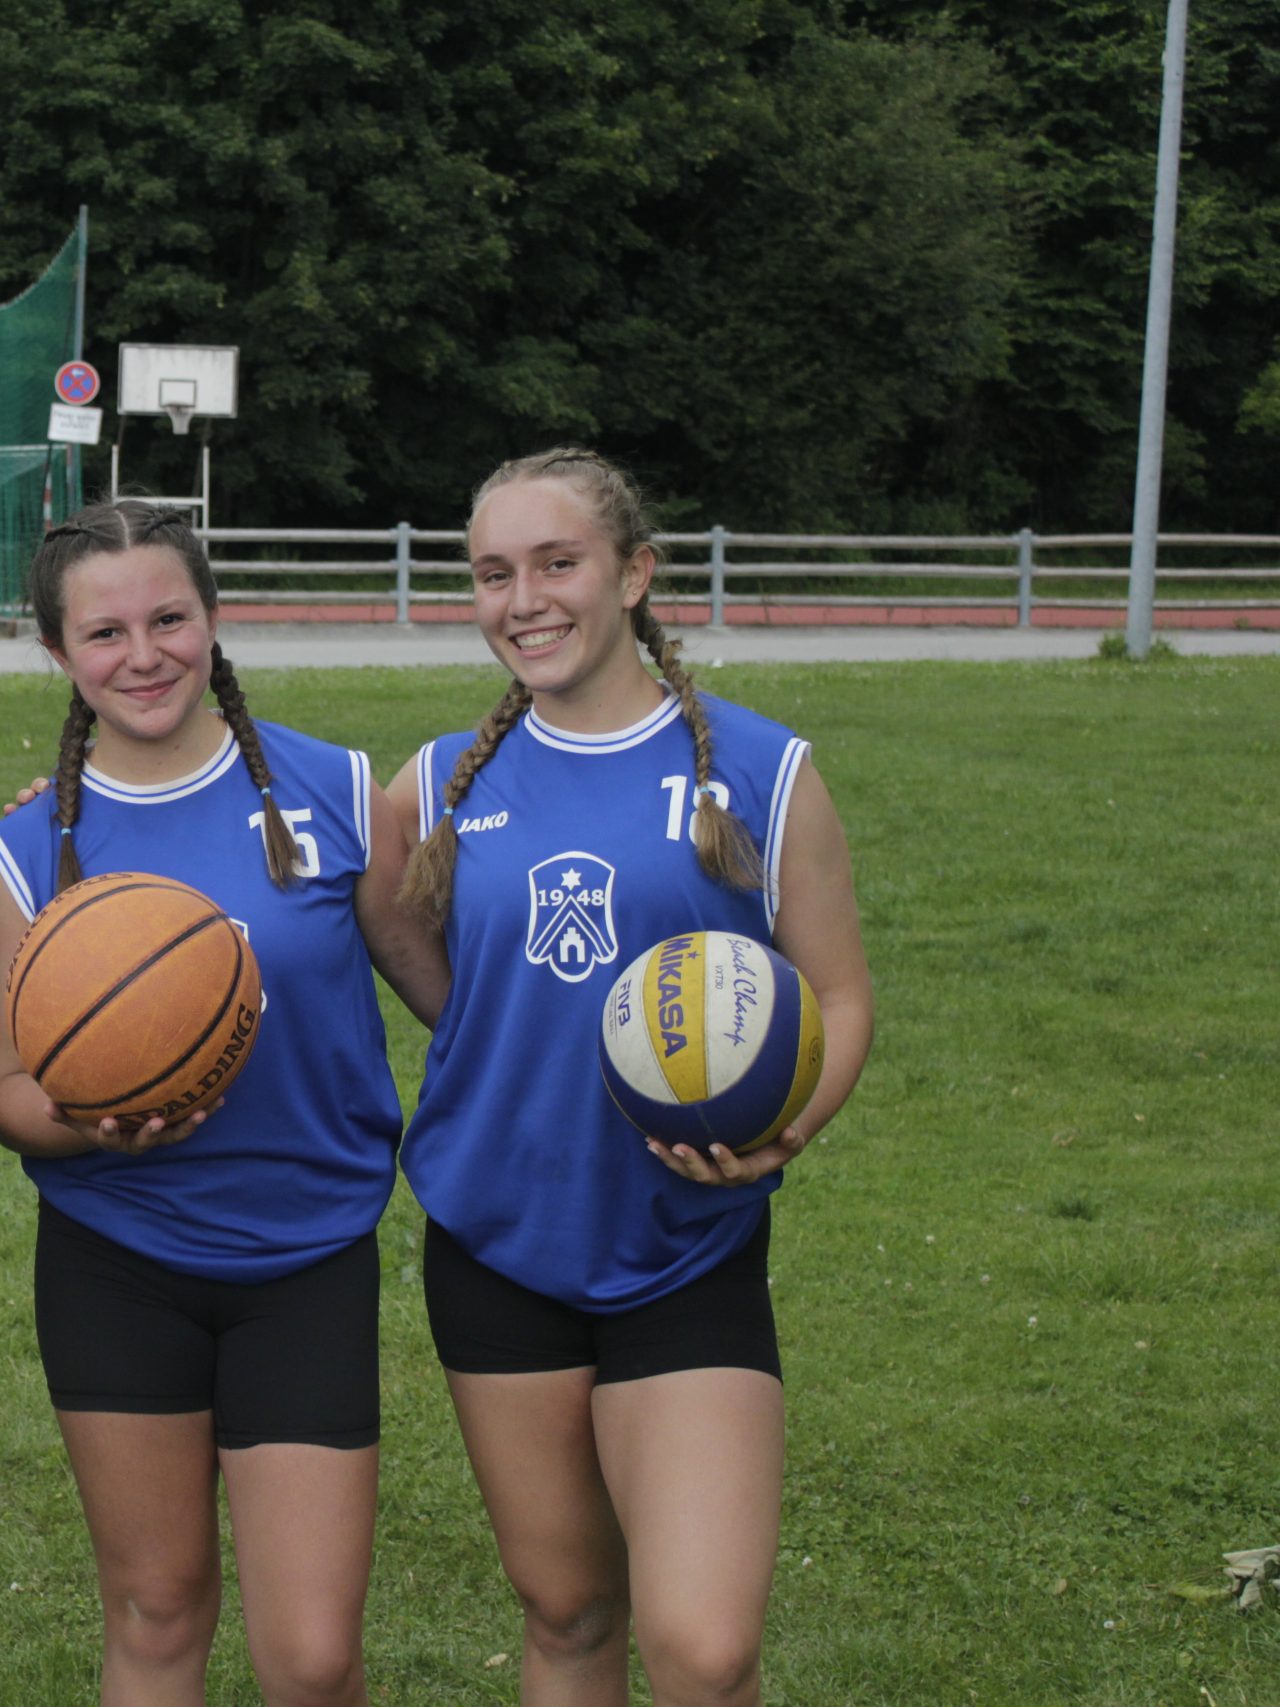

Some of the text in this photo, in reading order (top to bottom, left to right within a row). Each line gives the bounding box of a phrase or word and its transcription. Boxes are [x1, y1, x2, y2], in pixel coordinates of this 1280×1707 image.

[457, 810, 509, 834] JAKO
[538, 889, 604, 907] 19 48
[618, 978, 632, 1027] FIVB
[657, 937, 694, 1058] MIKASA
[724, 978, 758, 1047] Champ
